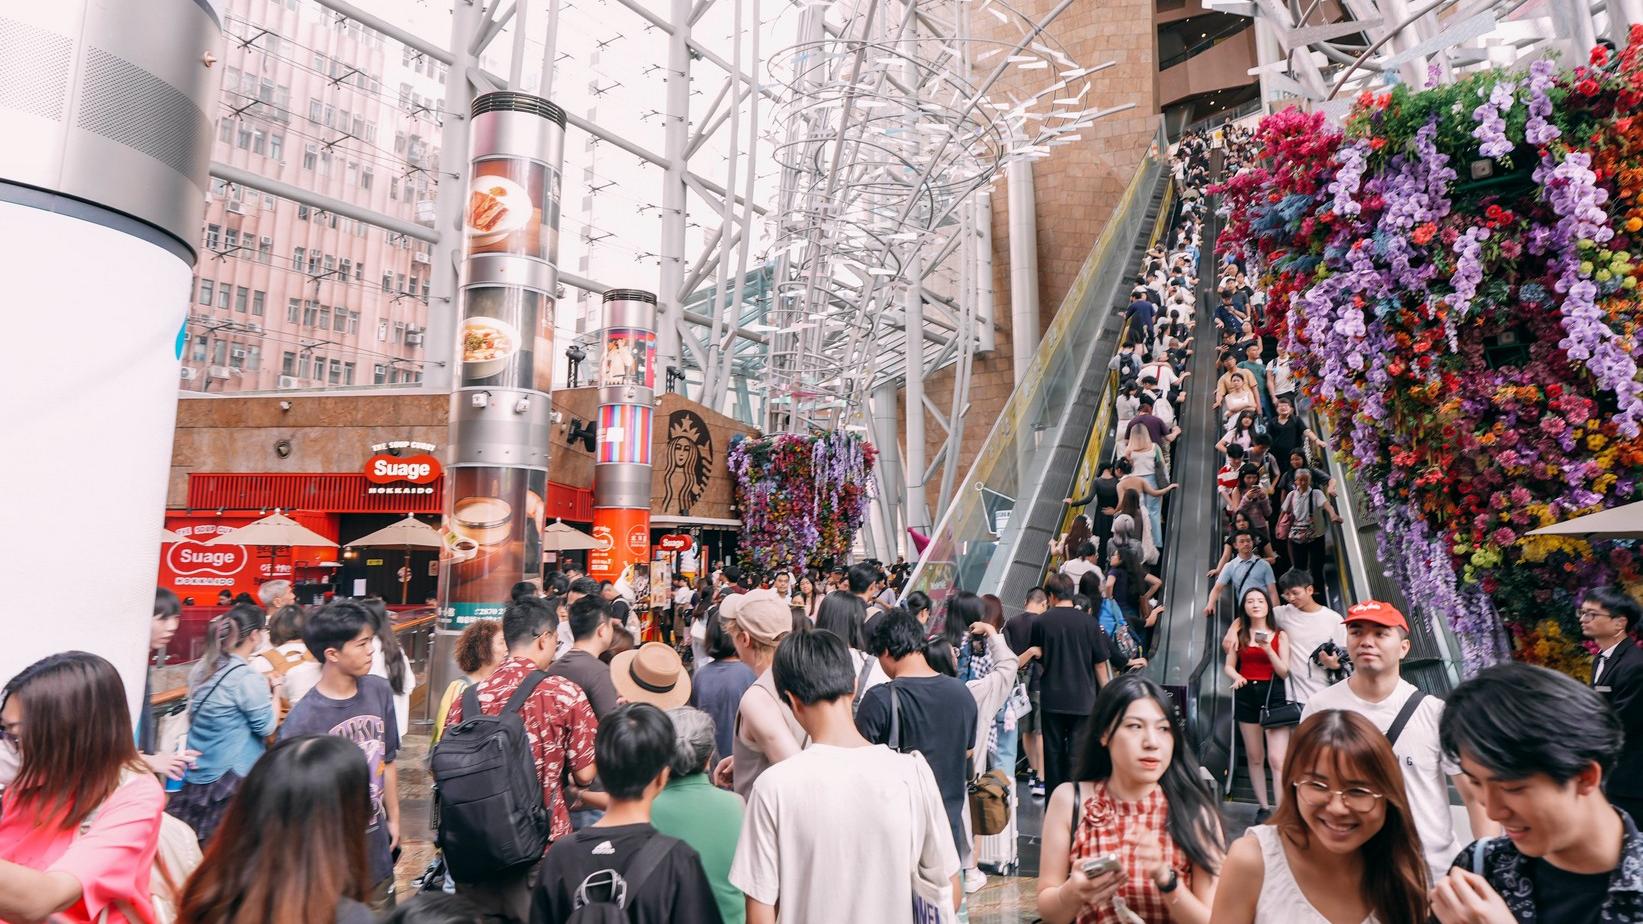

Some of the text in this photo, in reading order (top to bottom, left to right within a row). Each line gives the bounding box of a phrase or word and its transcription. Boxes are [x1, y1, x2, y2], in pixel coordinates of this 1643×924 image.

[374, 460, 430, 479] Suage
[180, 549, 235, 566] Suage
[175, 577, 235, 586] HOKKAIDO
